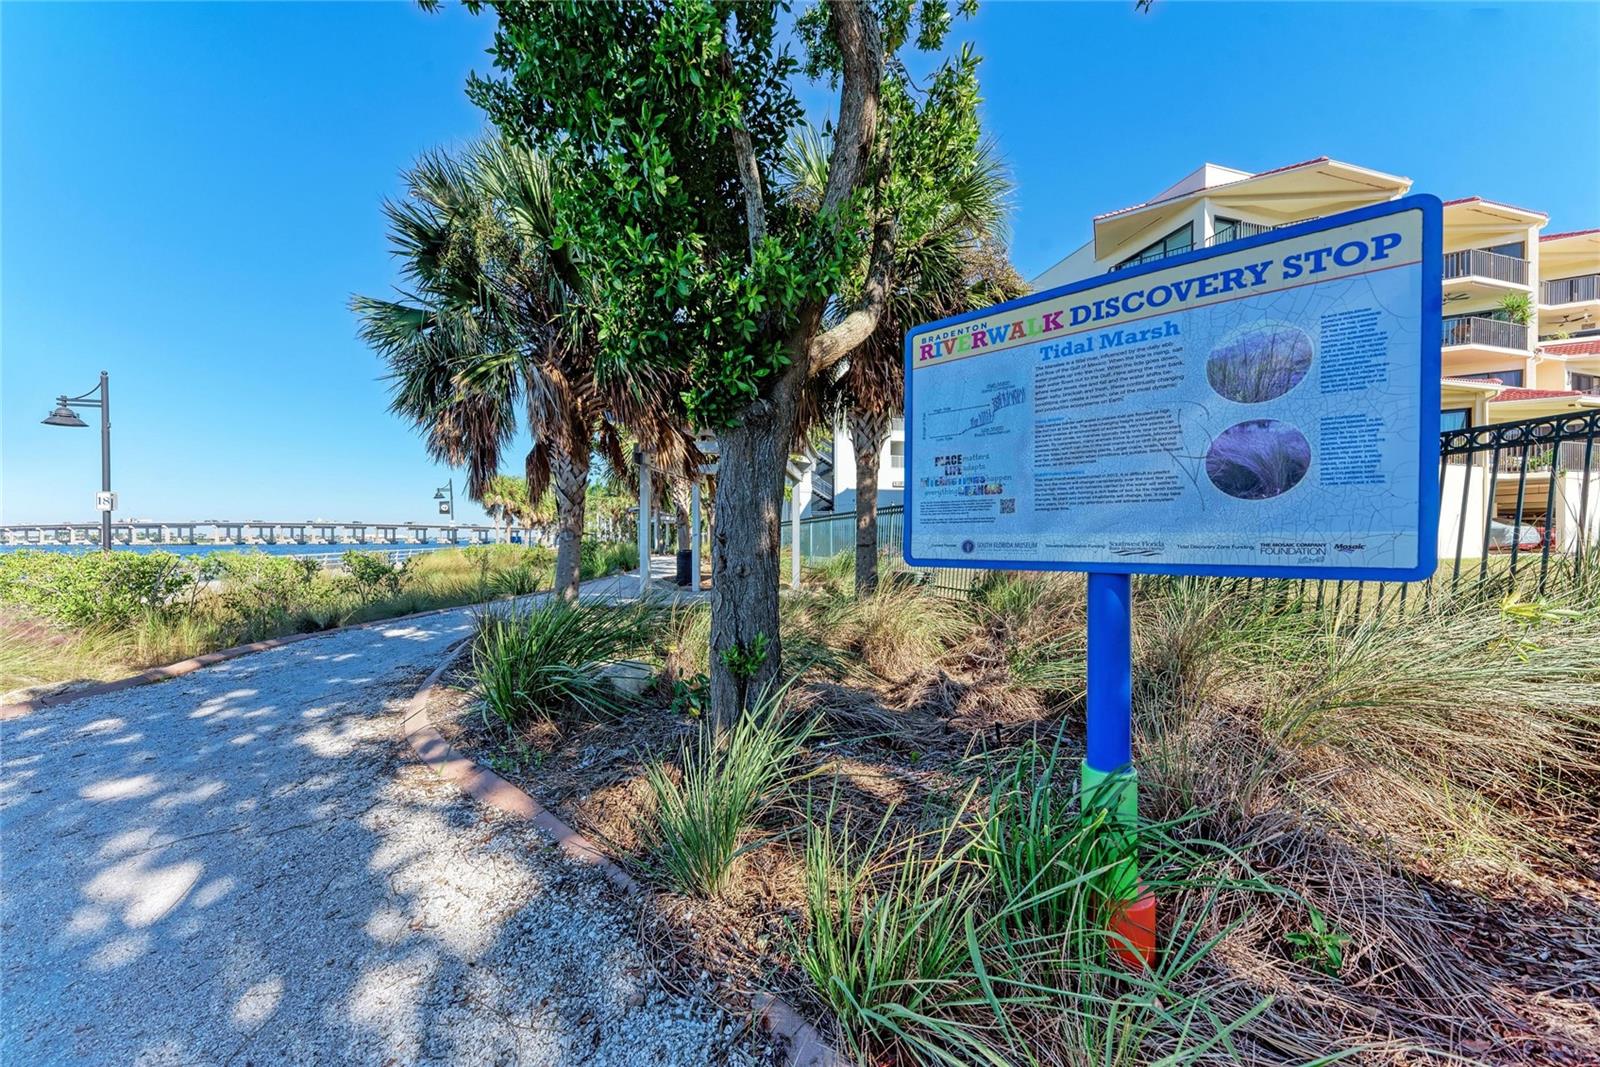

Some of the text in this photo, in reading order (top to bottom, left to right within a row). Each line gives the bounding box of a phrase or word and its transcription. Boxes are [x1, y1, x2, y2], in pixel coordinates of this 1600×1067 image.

[920, 232, 1402, 361] RIVERWALK DISCOVERY STOP
[921, 322, 988, 344] BRADENTON
[1040, 320, 1180, 361] Tidal Marsh
[935, 455, 962, 466] PLACE
[945, 465, 962, 475] LIFE
[98, 496, 110, 506] 18
